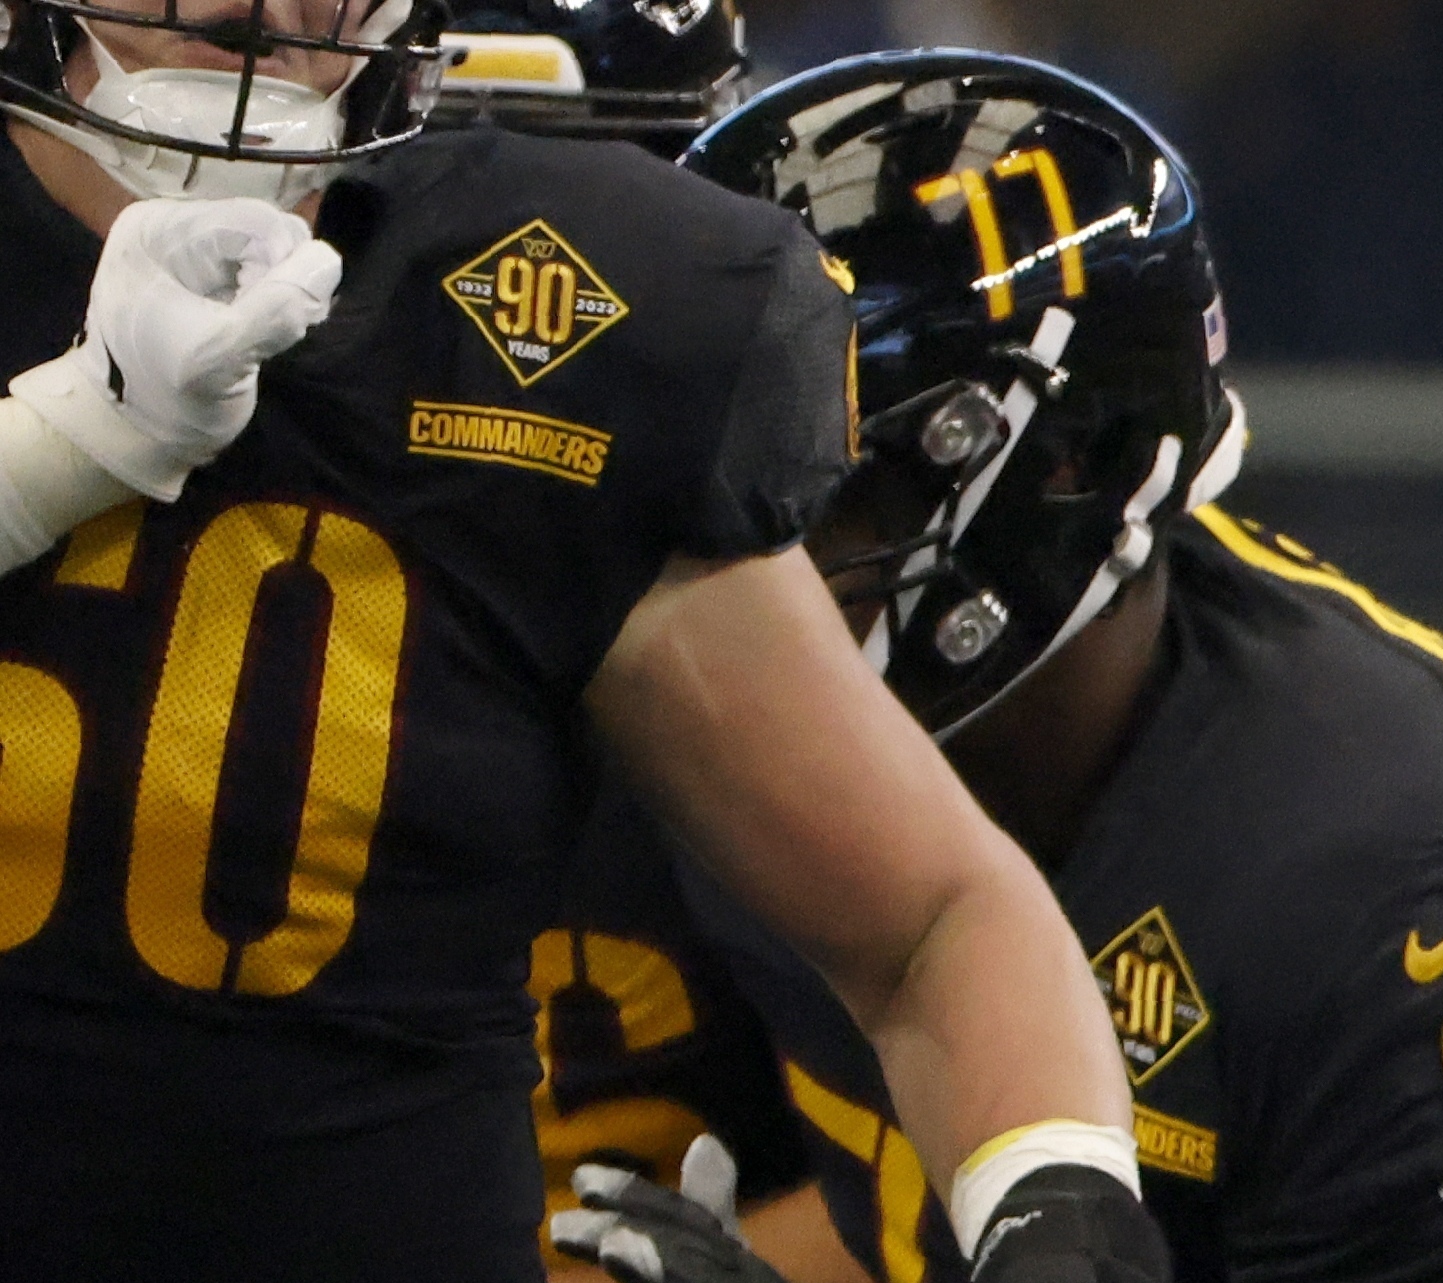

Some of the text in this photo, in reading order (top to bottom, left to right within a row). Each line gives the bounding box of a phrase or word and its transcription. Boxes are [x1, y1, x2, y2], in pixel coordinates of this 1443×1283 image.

[912, 147, 1086, 321] 77
[494, 254, 576, 345] 90
[506, 340, 550, 363] YEARS
[409, 410, 608, 475] COMMANDERS
[1113, 951, 1176, 1045] 90
